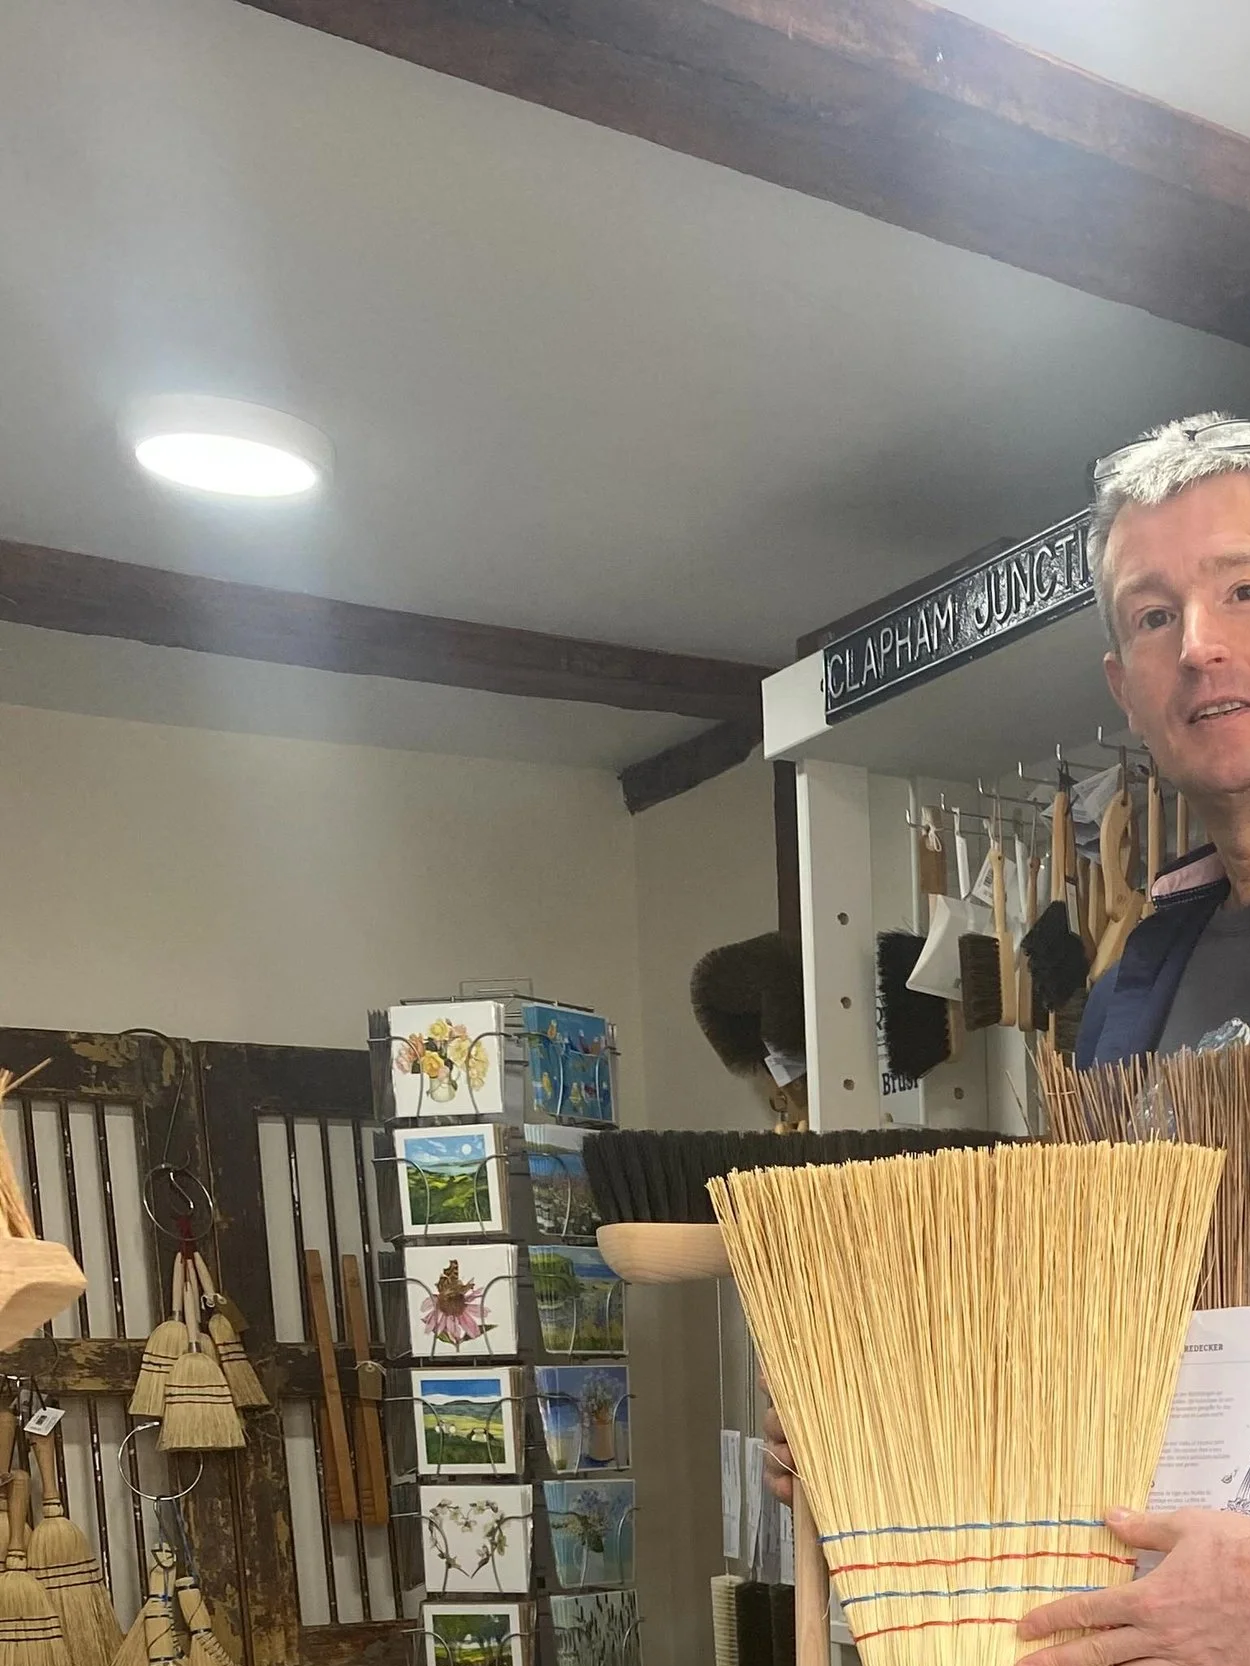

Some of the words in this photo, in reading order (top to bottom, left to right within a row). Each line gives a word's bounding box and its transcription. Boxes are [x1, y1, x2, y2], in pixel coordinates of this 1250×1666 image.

[829, 594, 956, 699] CLAPHAM
[974, 528, 1088, 631] JUNCTI
[1183, 1343, 1224, 1353] REDECKER
